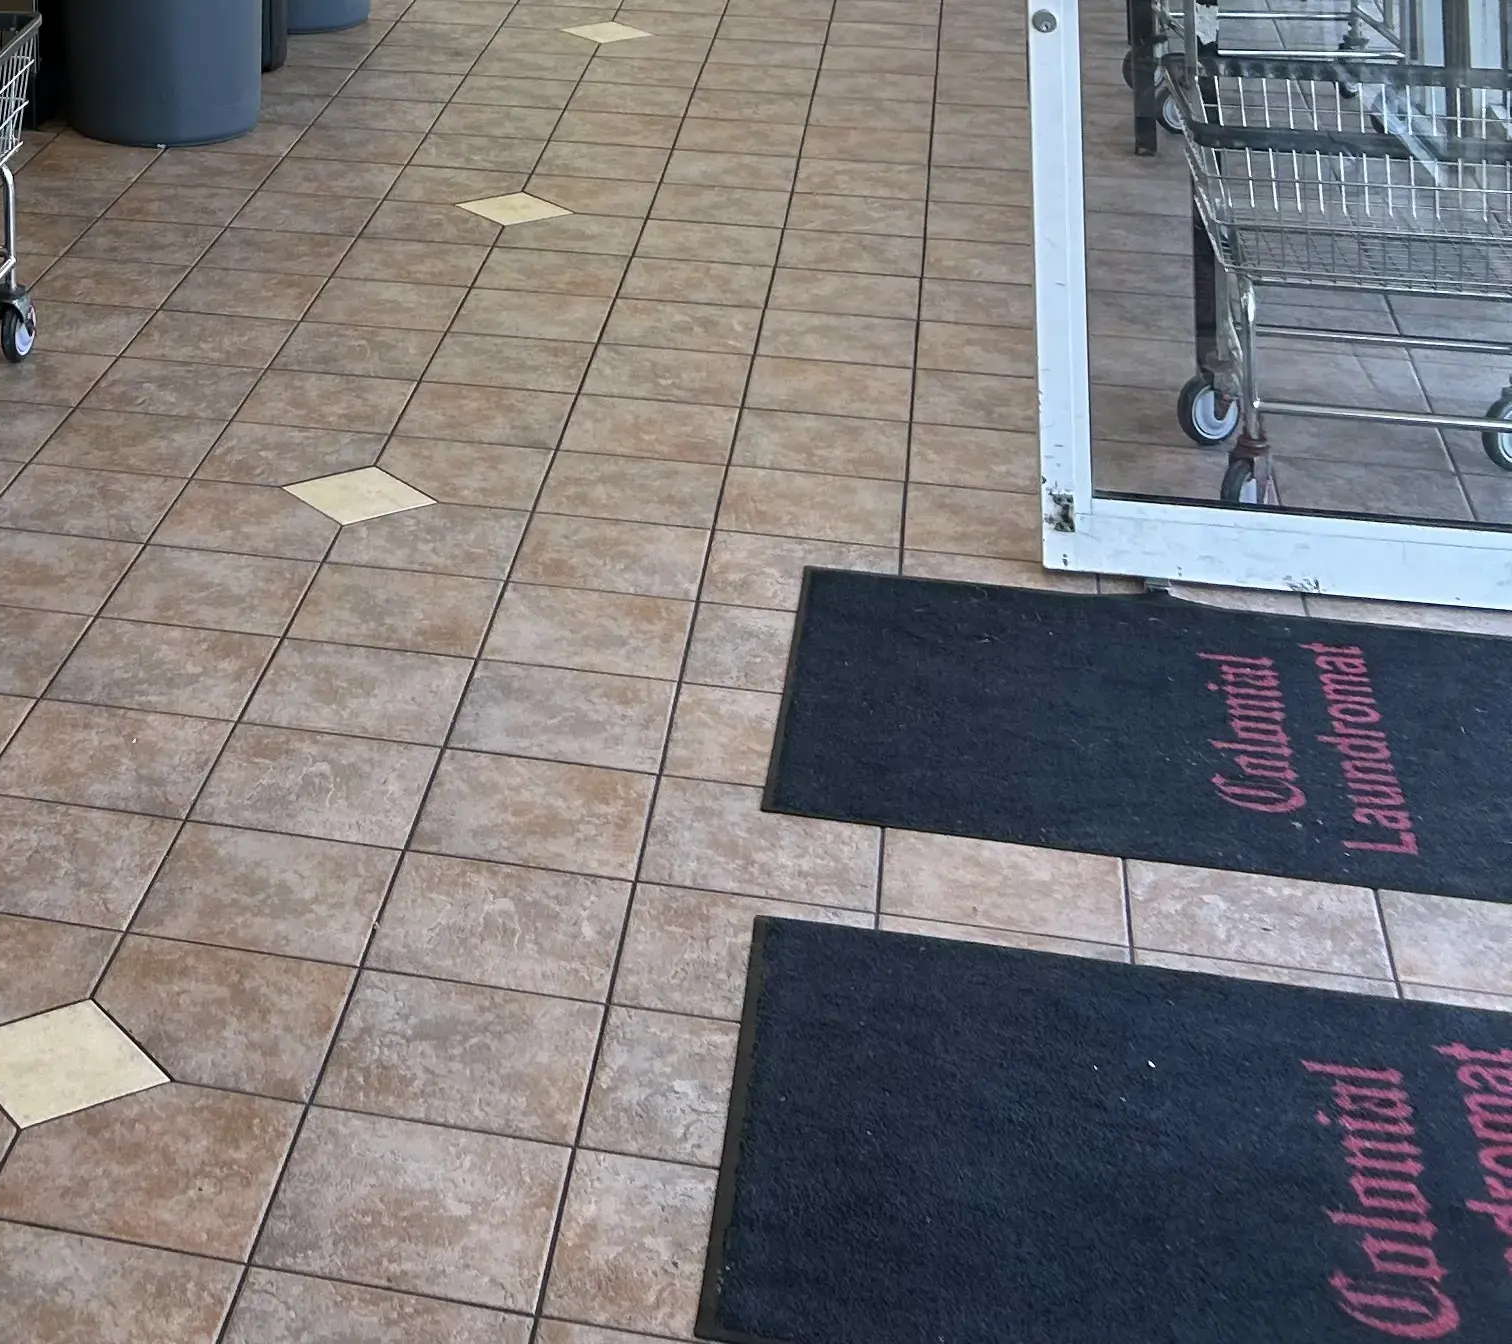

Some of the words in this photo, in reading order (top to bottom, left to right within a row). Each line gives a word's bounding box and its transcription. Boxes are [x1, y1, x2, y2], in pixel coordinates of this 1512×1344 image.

[1198, 651, 1307, 814] Colonial
[1298, 641, 1420, 857] Laundromat
[1301, 1058, 1460, 1339] Colonial
